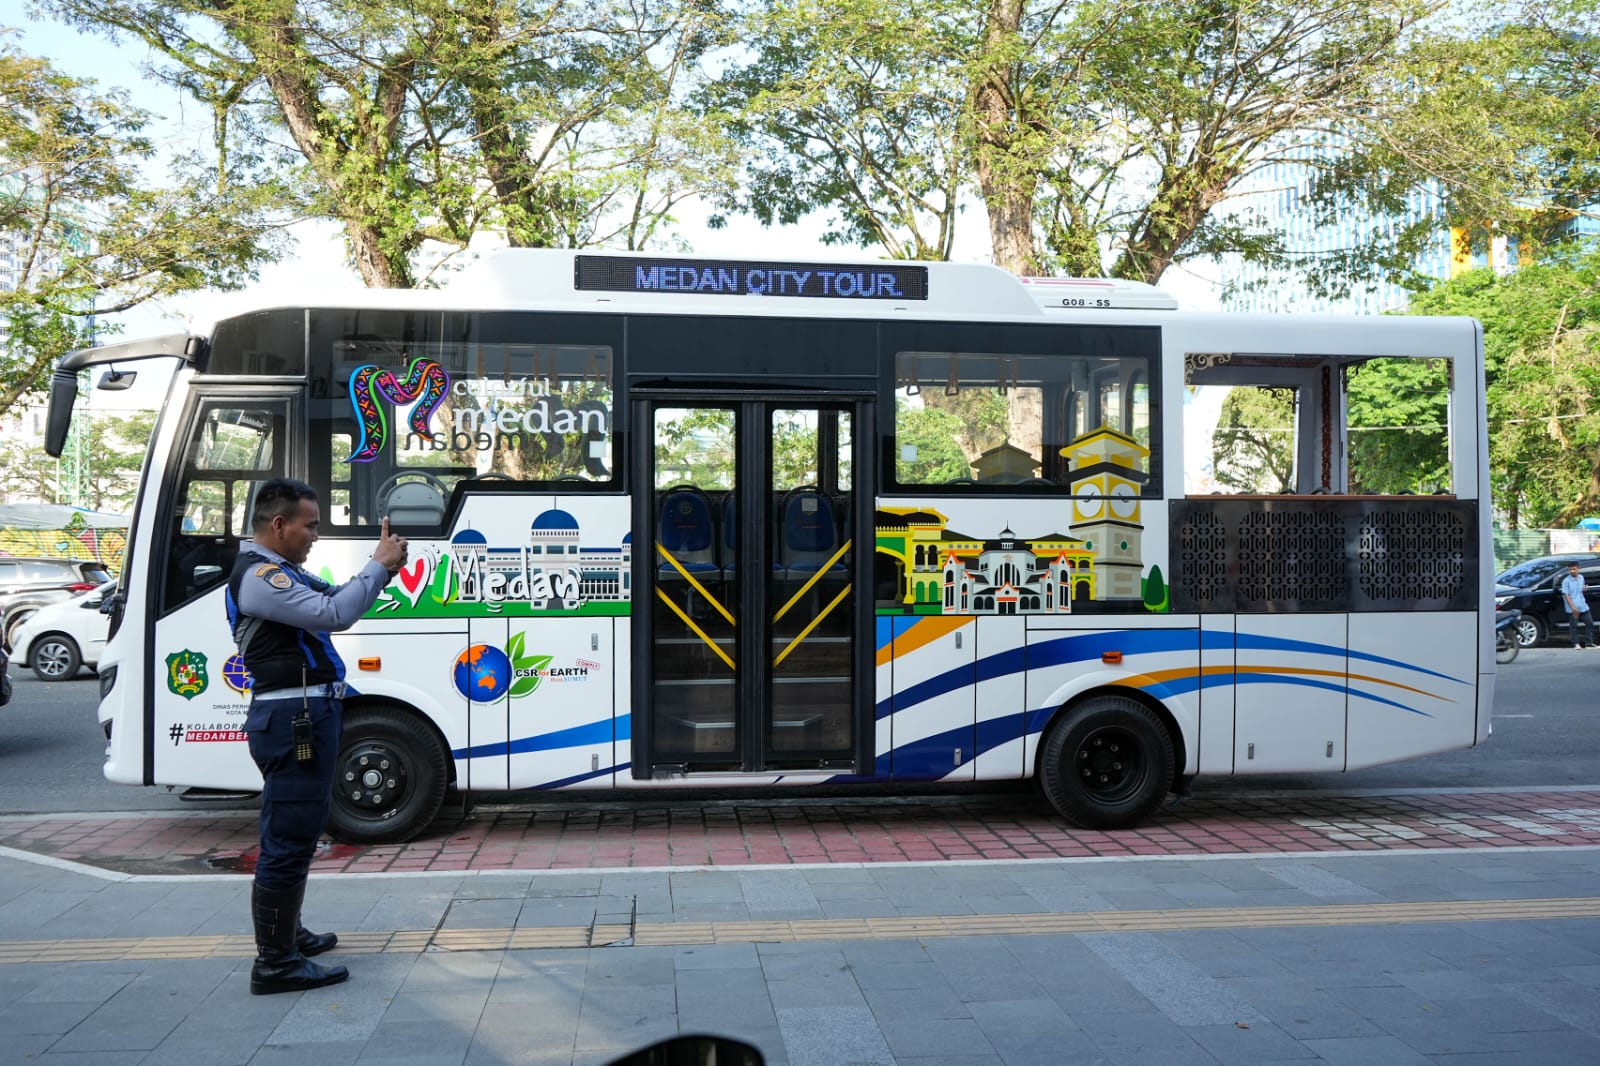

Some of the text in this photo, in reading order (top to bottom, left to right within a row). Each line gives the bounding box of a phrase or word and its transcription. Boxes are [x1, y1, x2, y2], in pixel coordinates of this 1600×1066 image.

[636, 265, 903, 296] MEDAN CITY TOUR
[1062, 298, 1085, 306] G08
[1096, 299, 1111, 307] SS
[453, 400, 607, 434] medan
[443, 545, 581, 604] Medan
[515, 669, 538, 677] CSR
[550, 668, 588, 676] EARTH
[187, 723, 245, 731] KOLABORA
[187, 732, 226, 740] MEDAN
